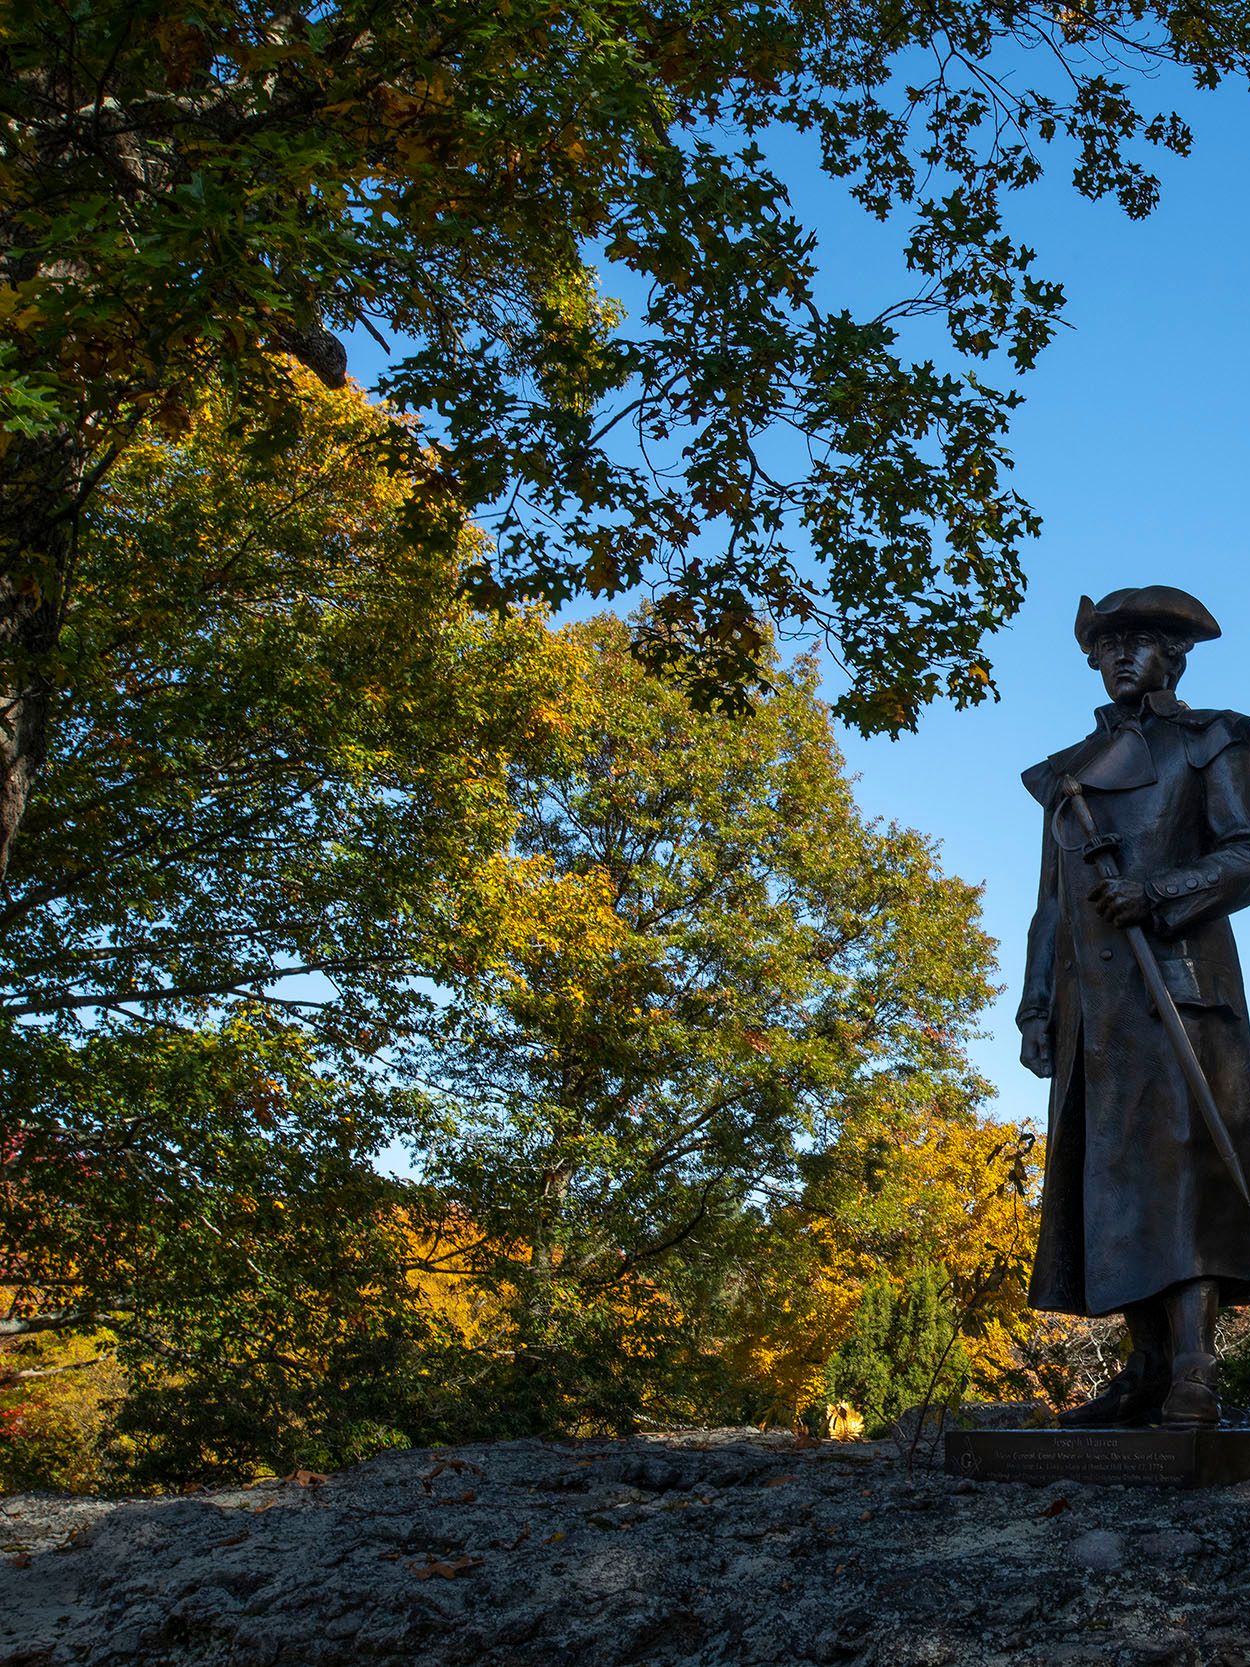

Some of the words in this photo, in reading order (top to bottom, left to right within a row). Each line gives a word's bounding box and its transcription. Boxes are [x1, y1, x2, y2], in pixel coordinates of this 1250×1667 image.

[1053, 1437, 1083, 1449] Joseph
[1086, 1437, 1119, 1448] Warren
[961, 1452, 972, 1469] G
